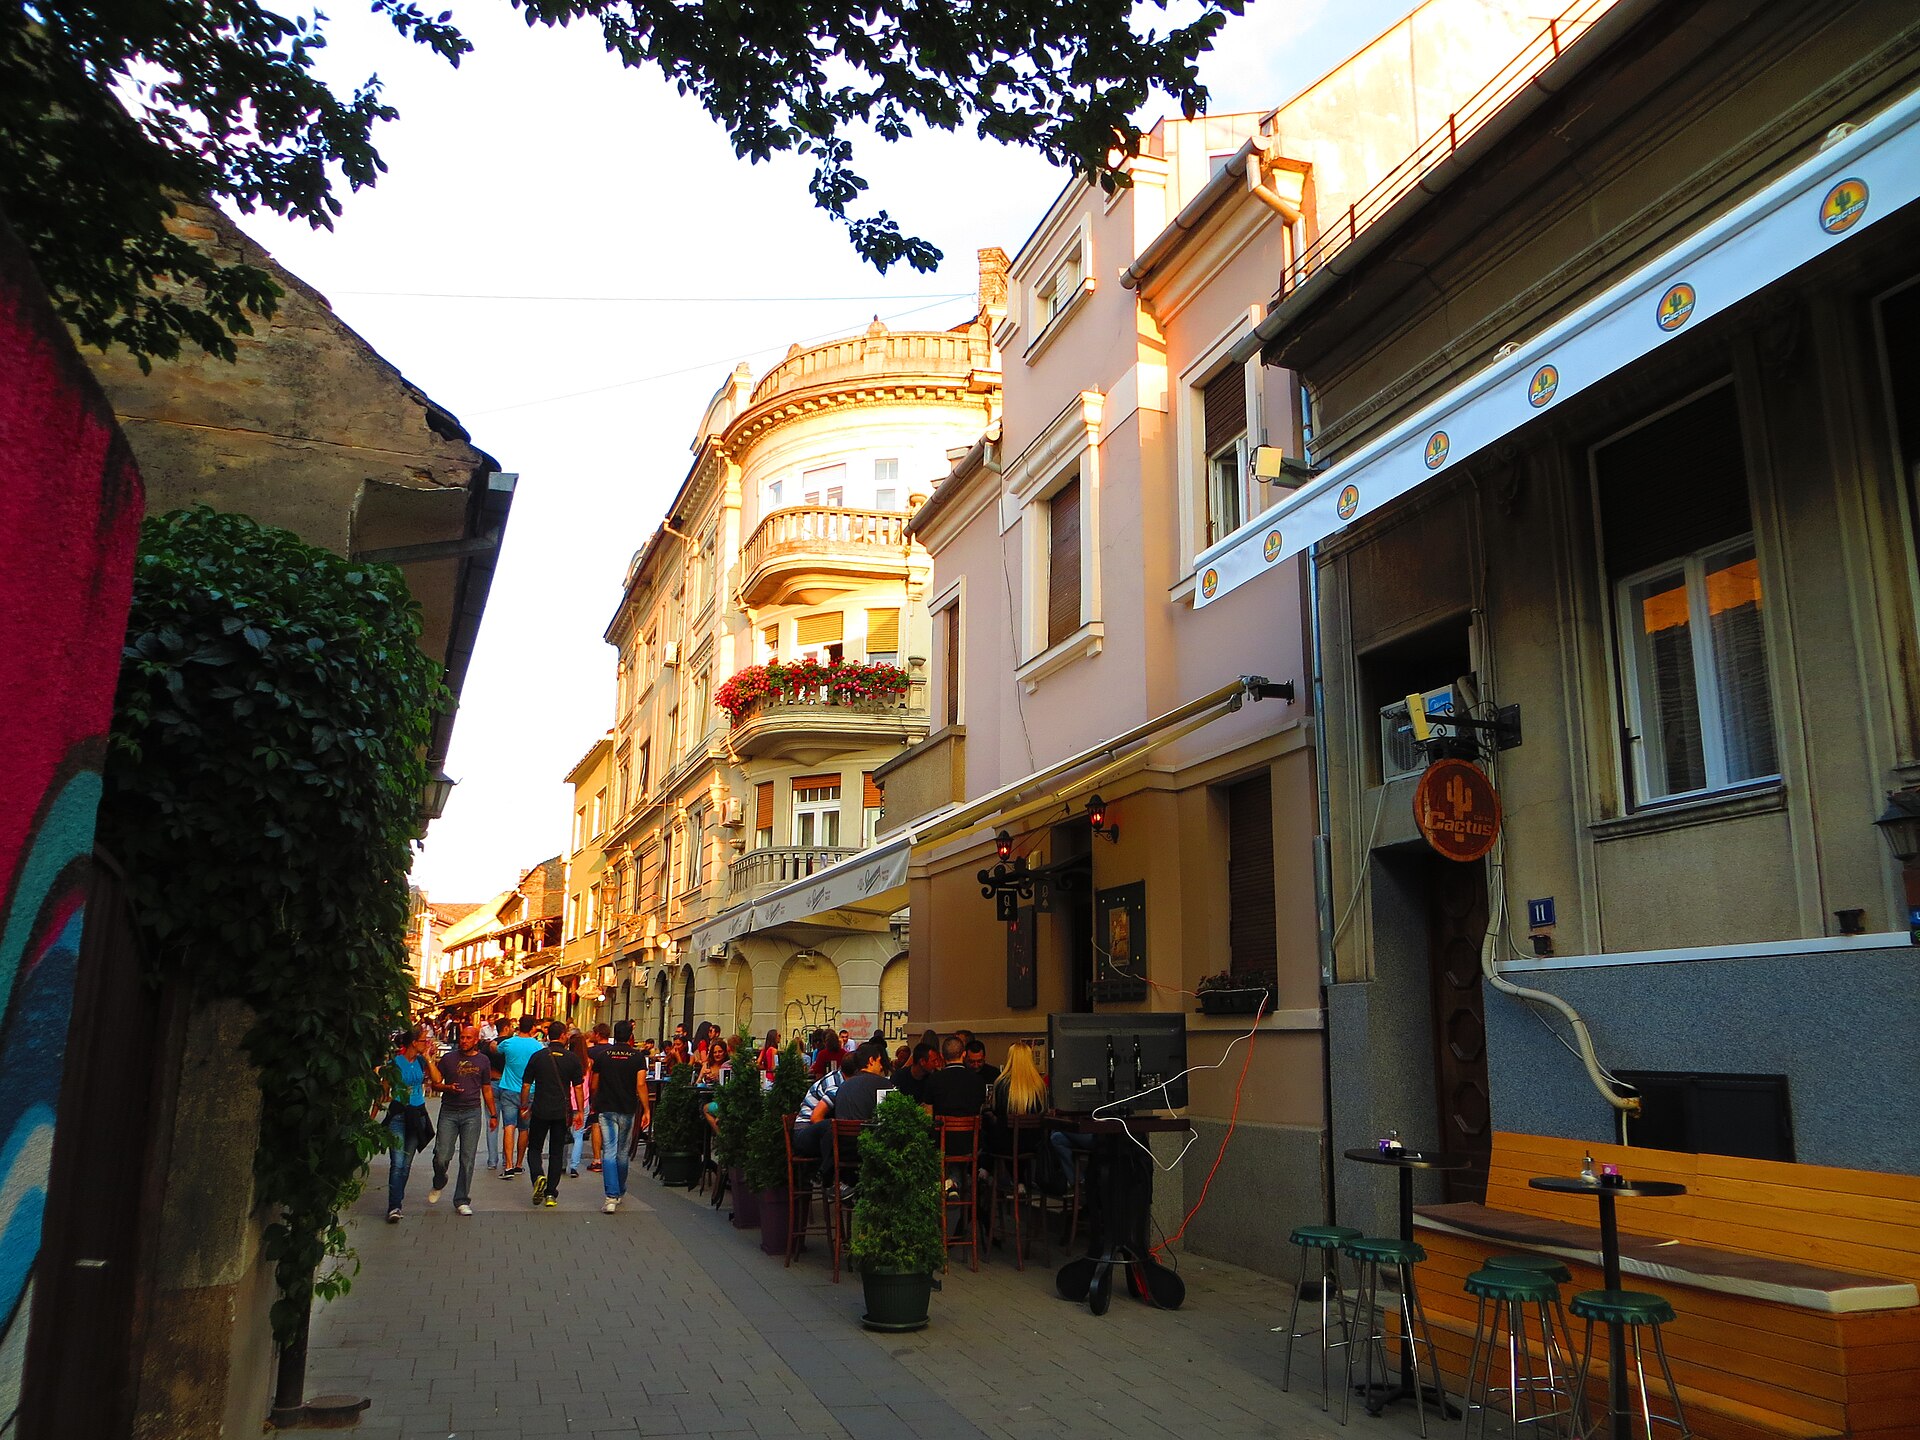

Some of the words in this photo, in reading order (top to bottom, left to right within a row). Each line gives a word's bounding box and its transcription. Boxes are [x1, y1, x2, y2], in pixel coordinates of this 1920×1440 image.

[1827, 200, 1866, 226] Cactus
[1661, 304, 1693, 324] Cactus
[1531, 384, 1557, 402] Cactus
[1425, 810, 1493, 836] Cactus
[1004, 894, 1012, 907] Q
[1535, 904, 1547, 922] 11
